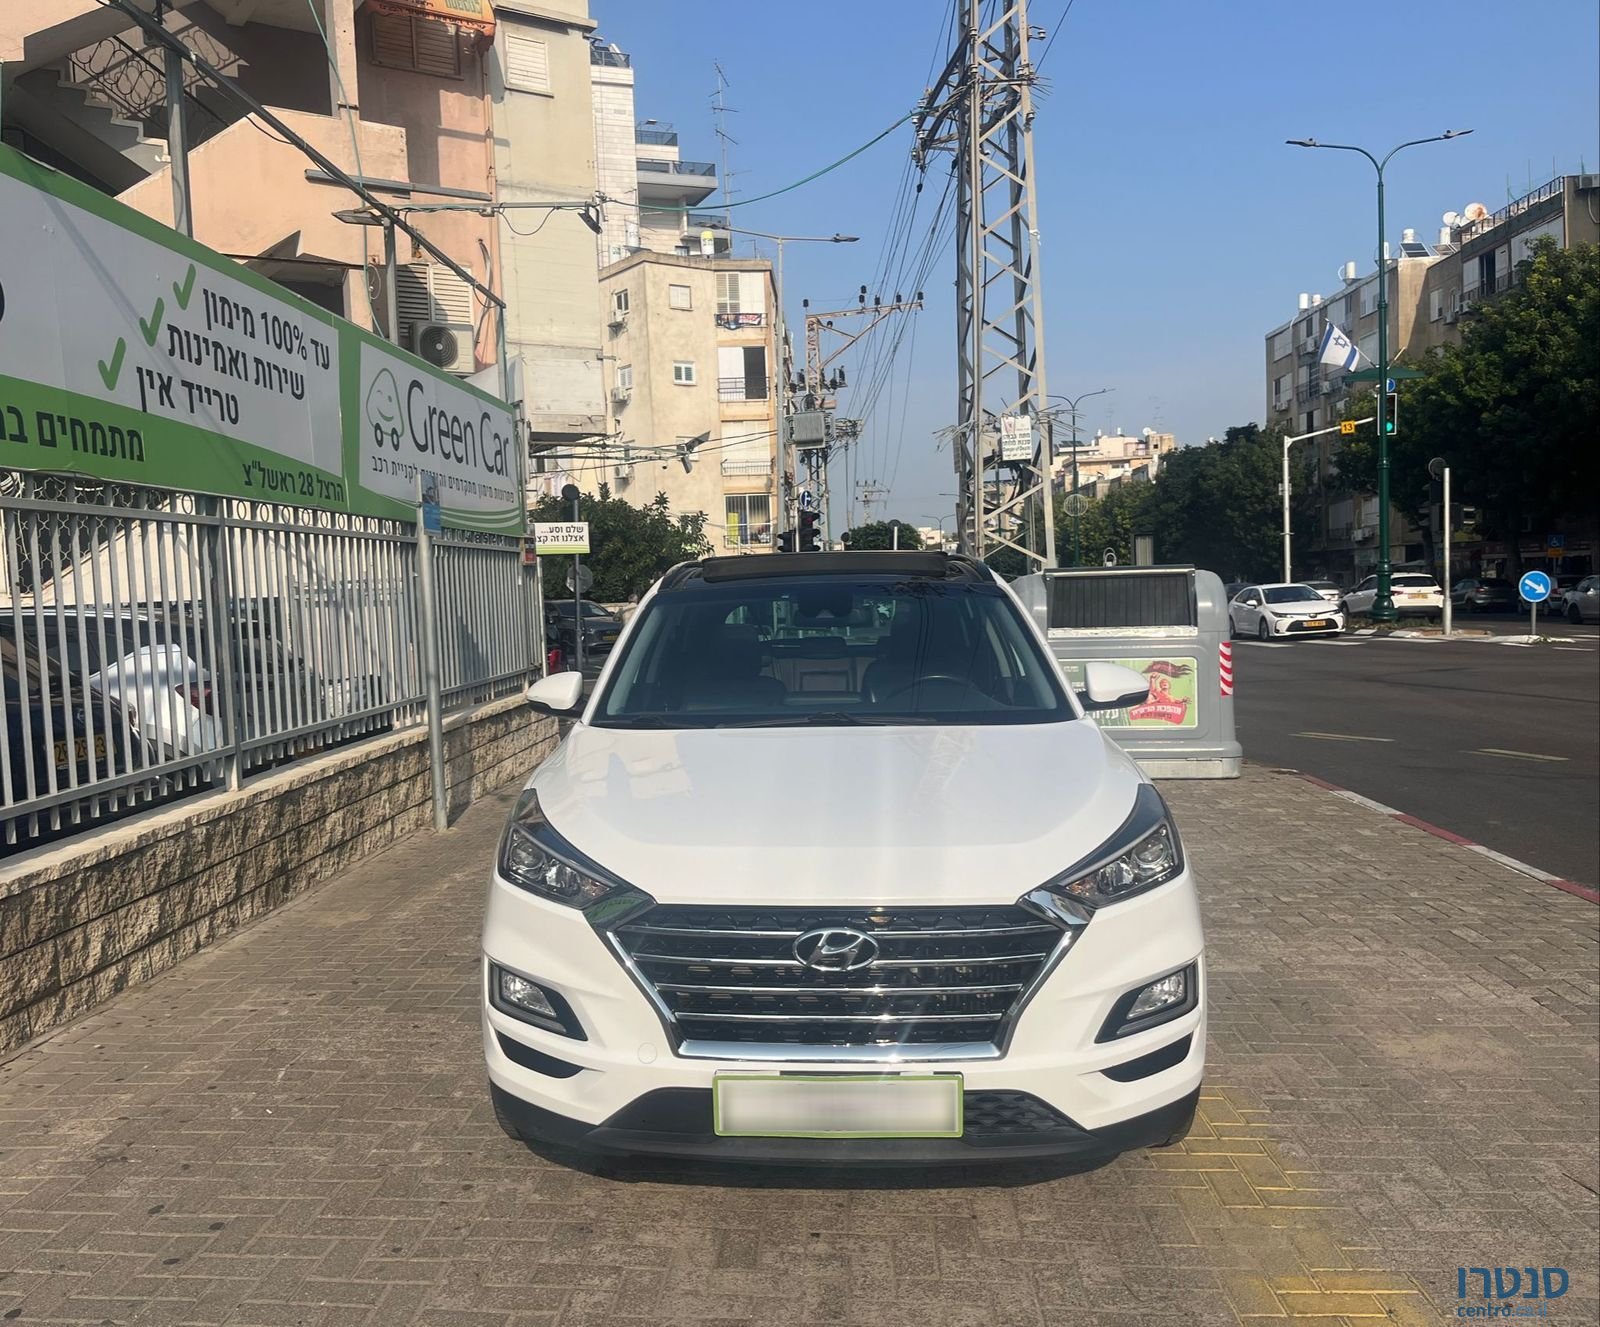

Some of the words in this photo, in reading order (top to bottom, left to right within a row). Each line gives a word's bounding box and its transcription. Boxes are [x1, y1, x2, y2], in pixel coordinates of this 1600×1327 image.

[202, 288, 256, 339] מימון
[261, 311, 307, 361] 100%
[167, 323, 249, 382] ואמינות
[310, 338, 330, 370] עד
[136, 366, 176, 413] אין
[253, 356, 305, 400] שירות
[180, 379, 240, 425] טרייד
[36, 411, 145, 462] מתמחים
[407, 379, 477, 468] Green
[479, 412, 509, 477] Car
[1343, 423, 1353, 432] 13
[371, 456, 389, 474] רכב
[391, 460, 418, 484] לקניית
[298, 471, 314, 497] 28
[316, 474, 345, 502] הרצל
[536, 535, 548, 544] קצ
[561, 533, 585, 542] אצלנו
[565, 524, 584, 533] שלם
